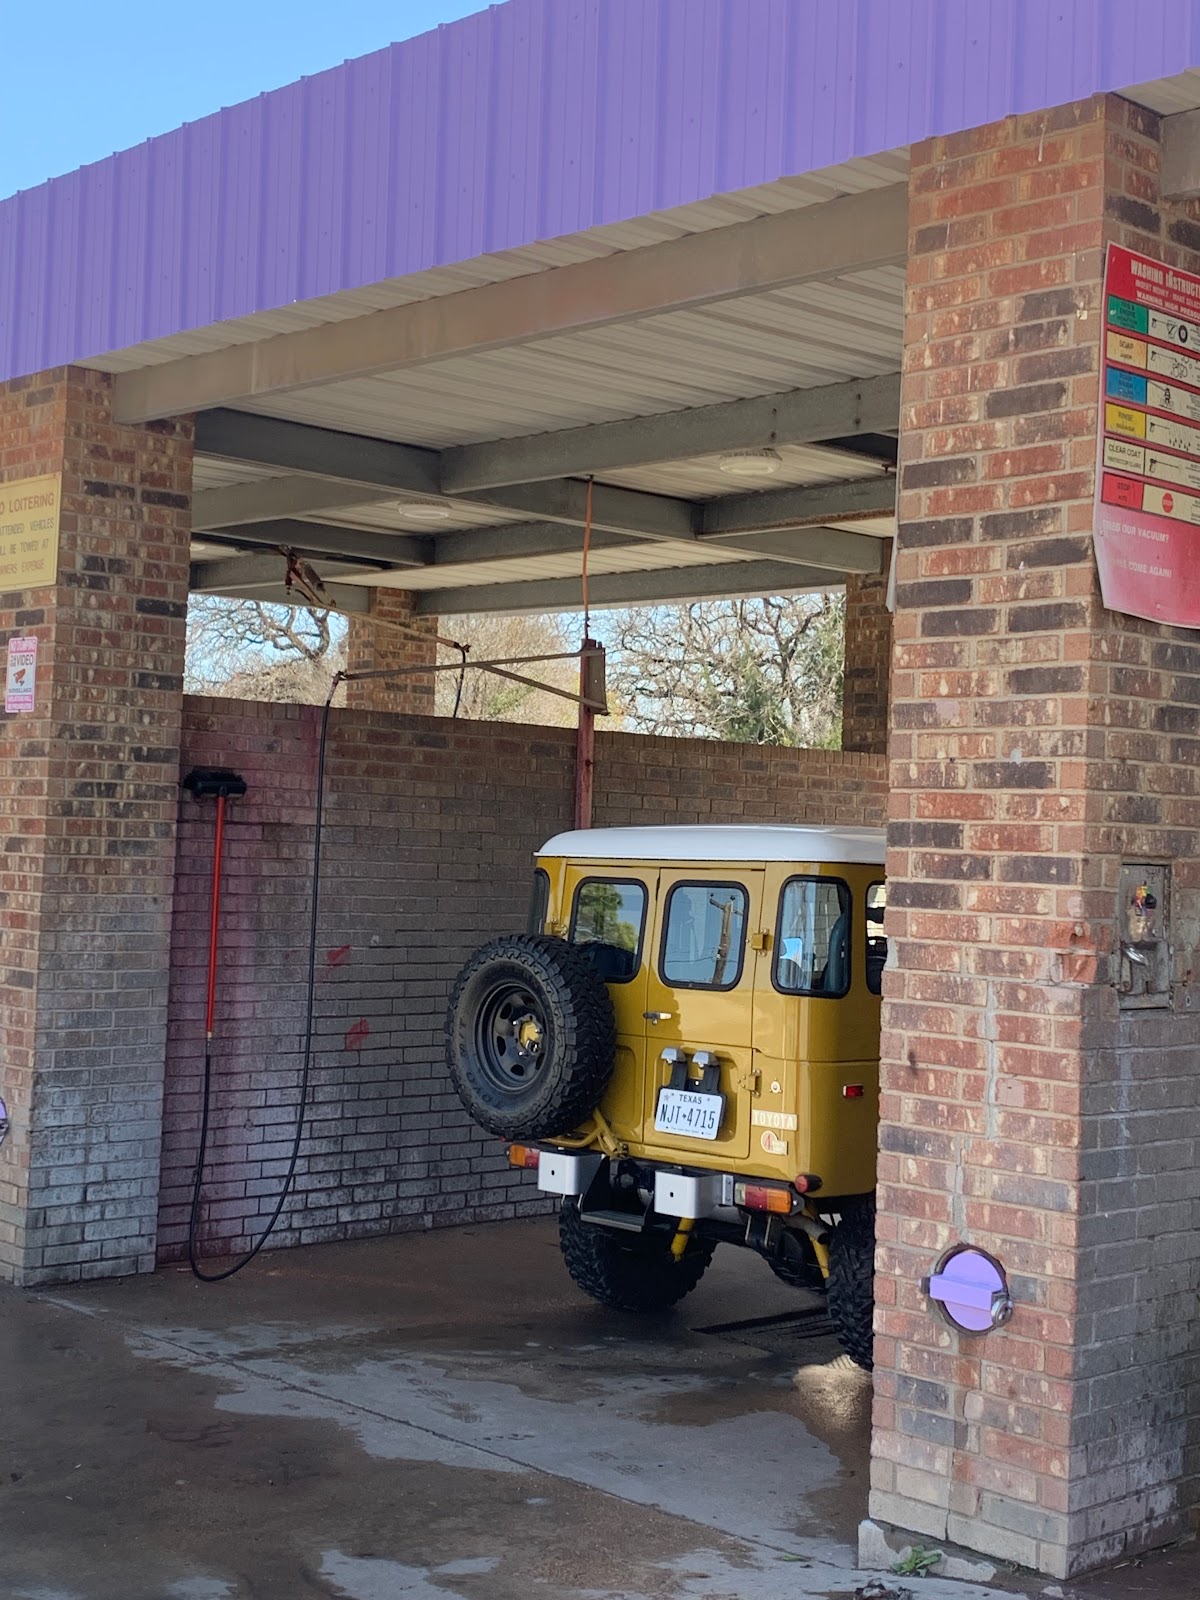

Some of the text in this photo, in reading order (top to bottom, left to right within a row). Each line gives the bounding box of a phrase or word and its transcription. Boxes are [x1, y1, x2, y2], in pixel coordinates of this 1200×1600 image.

[1131, 259, 1163, 285] WASHING
[1136, 290, 1163, 306] WARNING
[1108, 444, 1141, 459] CLEAR COAT
[9, 493, 54, 513] LOITERING
[1121, 524, 1136, 536] OUR
[1137, 527, 1170, 544] VACUUM?
[1128, 561, 1148, 574] COME
[17, 654, 34, 666] VIDEO
[679, 1094, 702, 1105] TEXAS
[753, 1111, 795, 1130] TOYOTA
